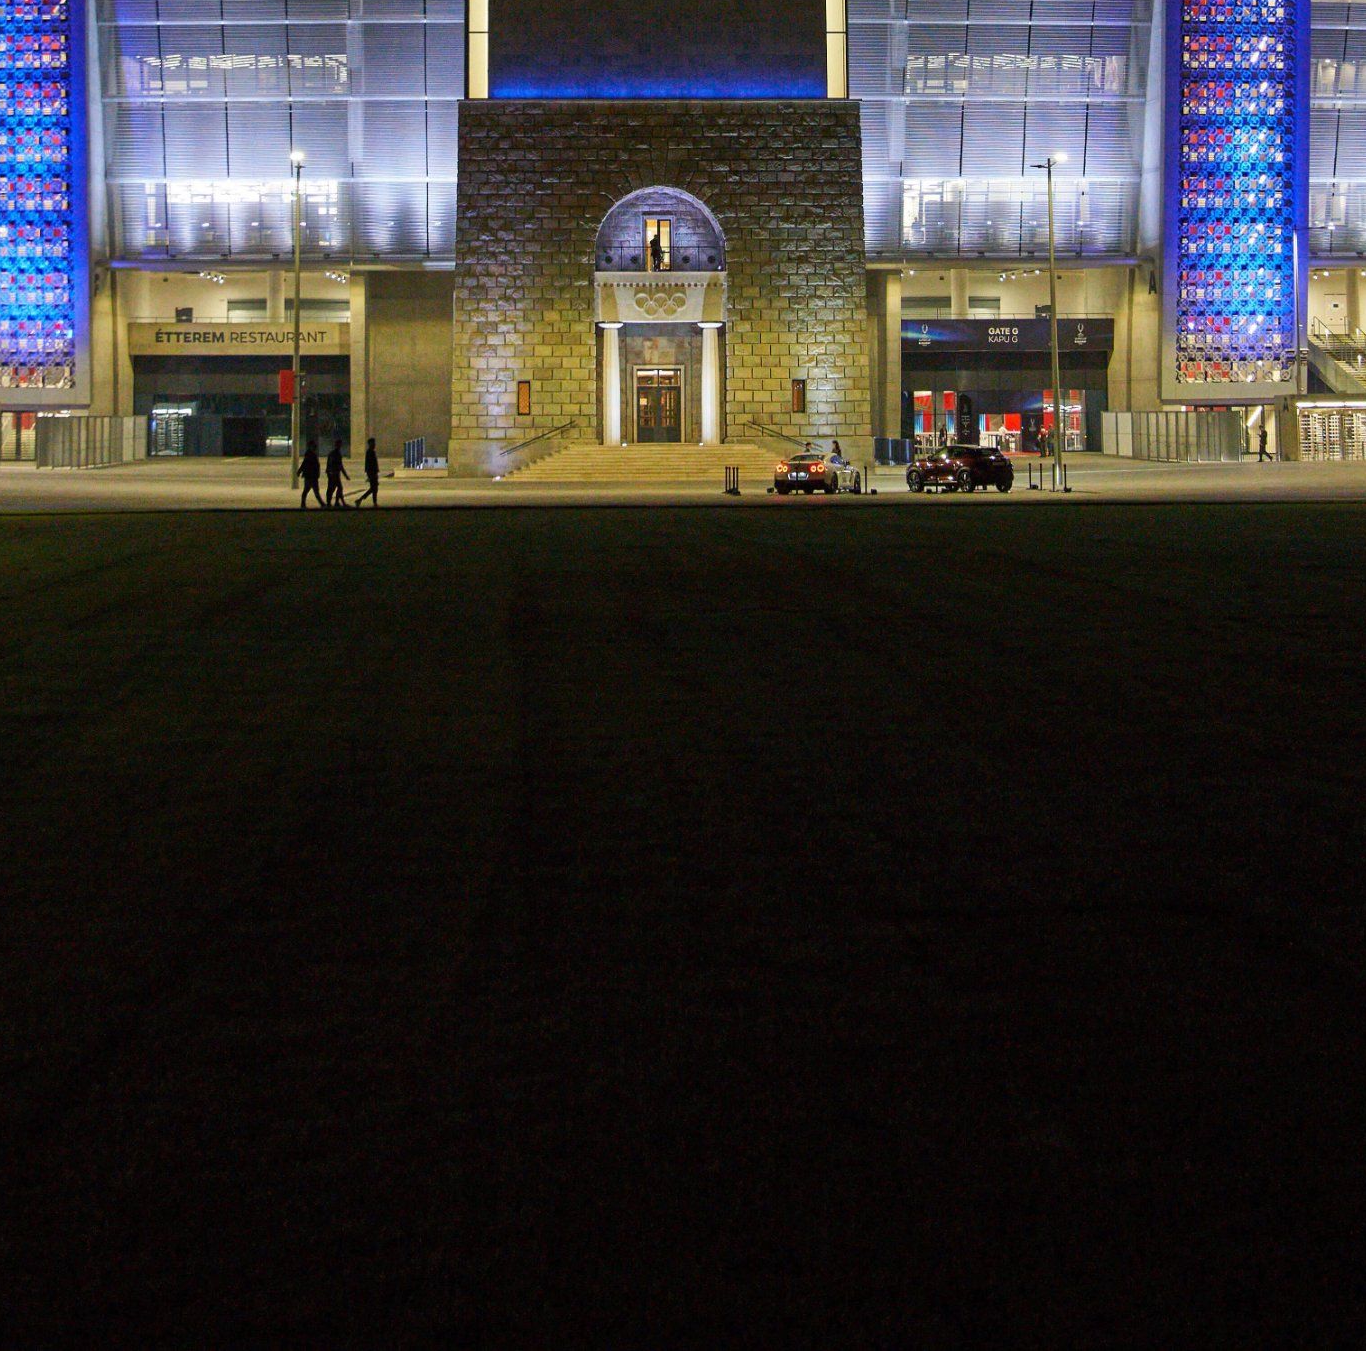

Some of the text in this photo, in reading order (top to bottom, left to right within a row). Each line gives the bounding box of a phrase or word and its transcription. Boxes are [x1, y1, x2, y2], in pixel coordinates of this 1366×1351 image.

[1149, 270, 1158, 295] A
[155, 328, 328, 344] ÉTTEREM RESTAURANT
[988, 327, 1019, 335] GATE G
[988, 335, 1019, 343] KAPU G
